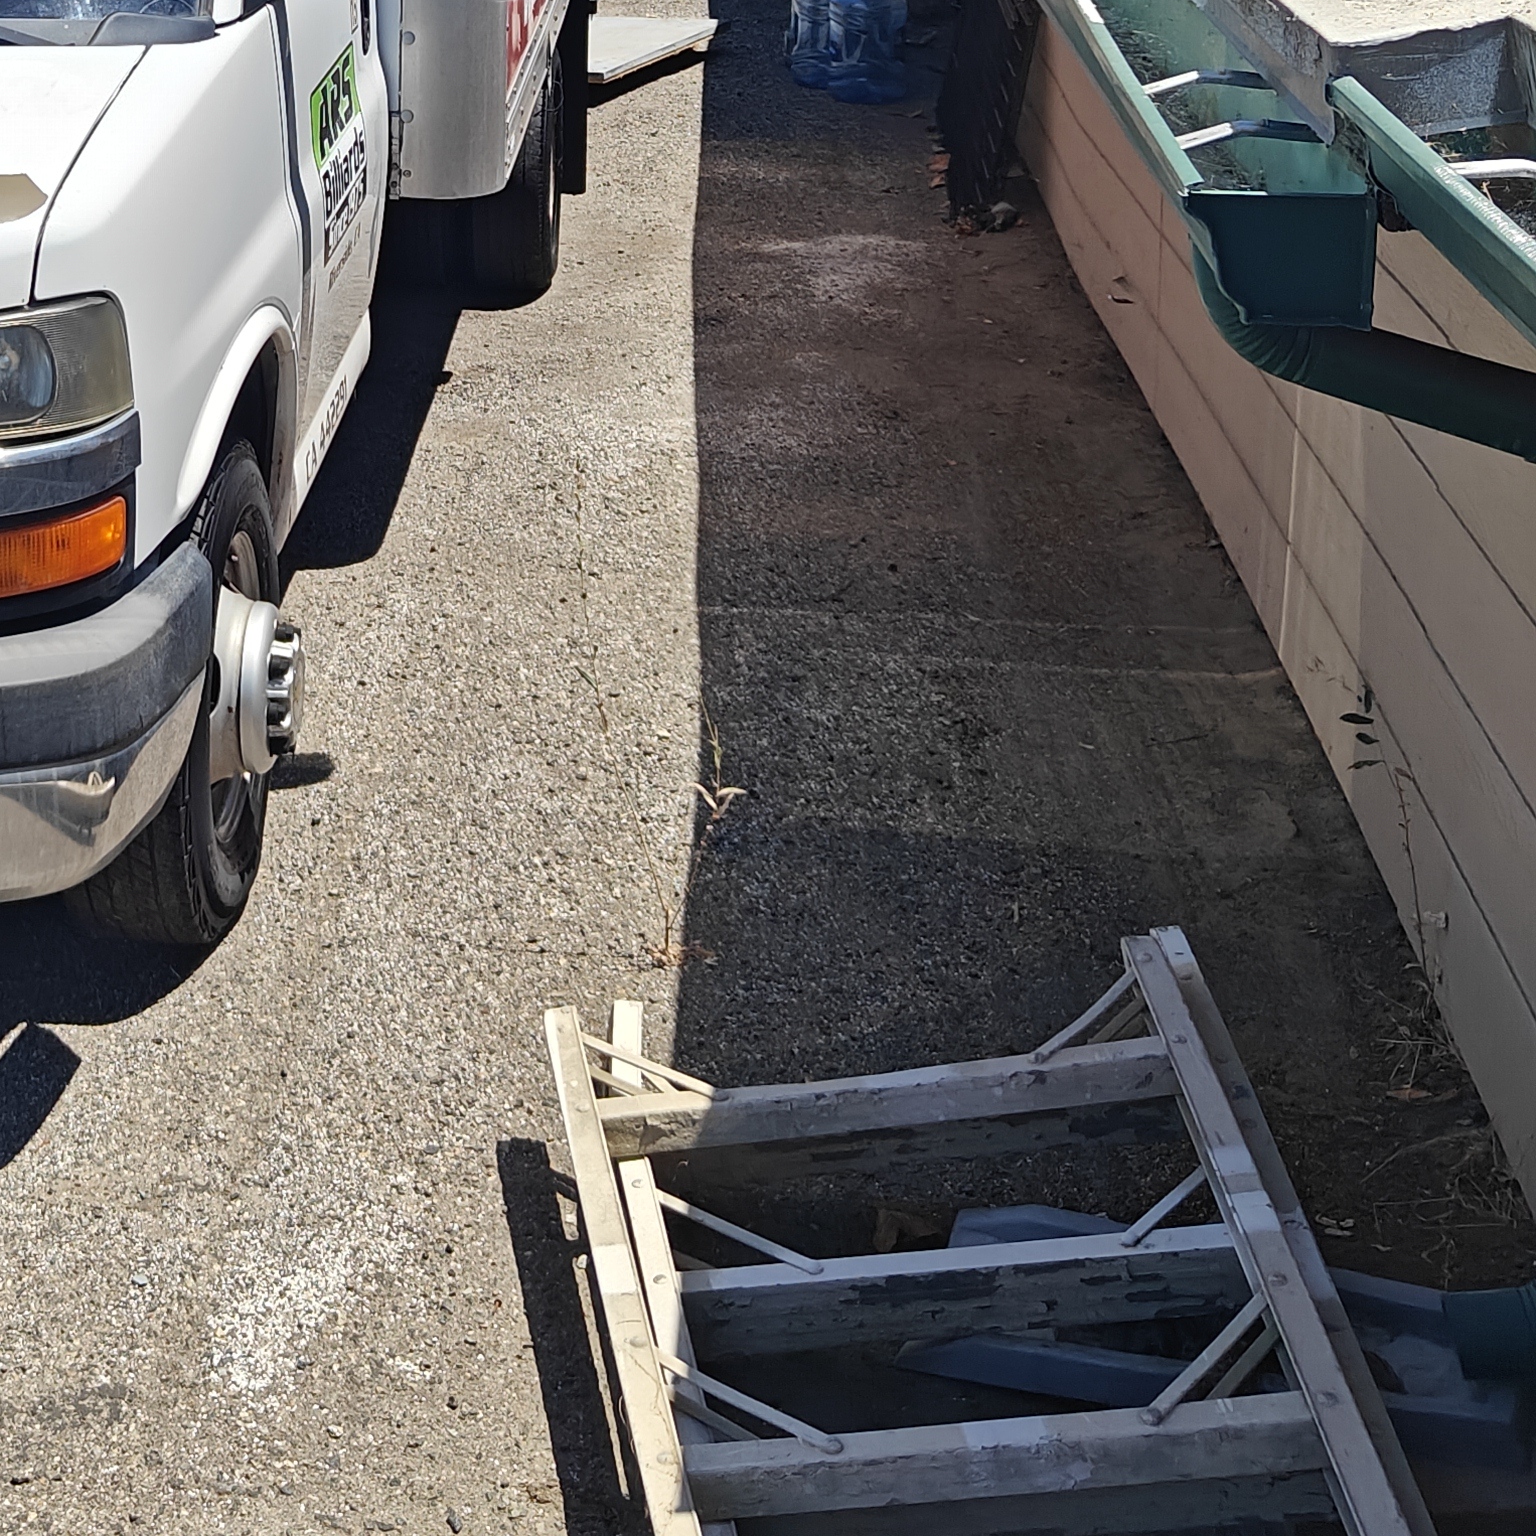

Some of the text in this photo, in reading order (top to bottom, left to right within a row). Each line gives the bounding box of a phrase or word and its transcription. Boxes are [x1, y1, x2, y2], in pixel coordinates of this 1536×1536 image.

[319, 53, 353, 161] ARS
[322, 126, 365, 222] Billiards
[305, 374, 348, 483] CA 442291
